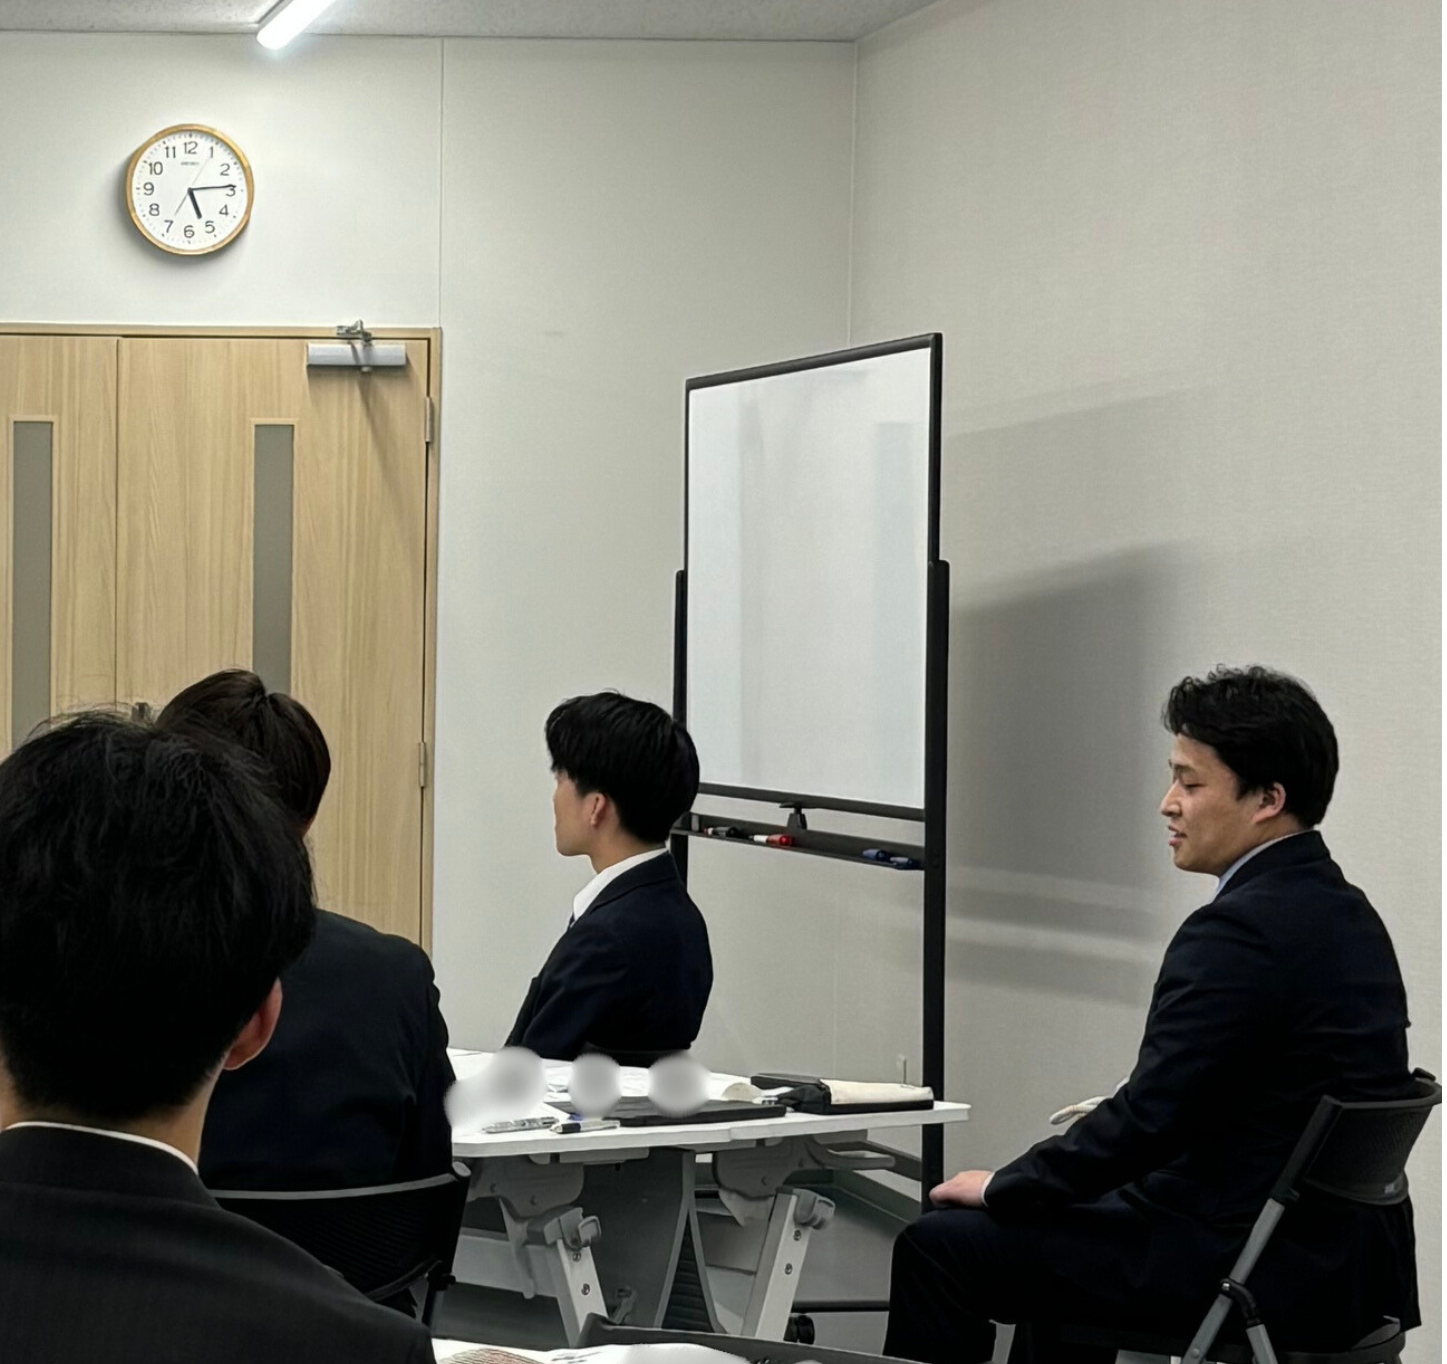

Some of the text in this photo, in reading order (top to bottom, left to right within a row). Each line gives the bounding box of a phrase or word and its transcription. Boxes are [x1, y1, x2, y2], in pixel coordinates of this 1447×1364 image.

[164, 146, 176, 158] 11
[184, 141, 198, 155] 12
[209, 146, 214, 158] 1
[148, 161, 164, 175] 10
[220, 163, 231, 176] 2
[143, 182, 154, 196] 9
[225, 184, 237, 197] 3
[149, 203, 160, 216] 8
[219, 204, 229, 216] 4
[164, 220, 174, 233] 7
[184, 225, 195, 238] 6
[205, 220, 216, 234] 5
